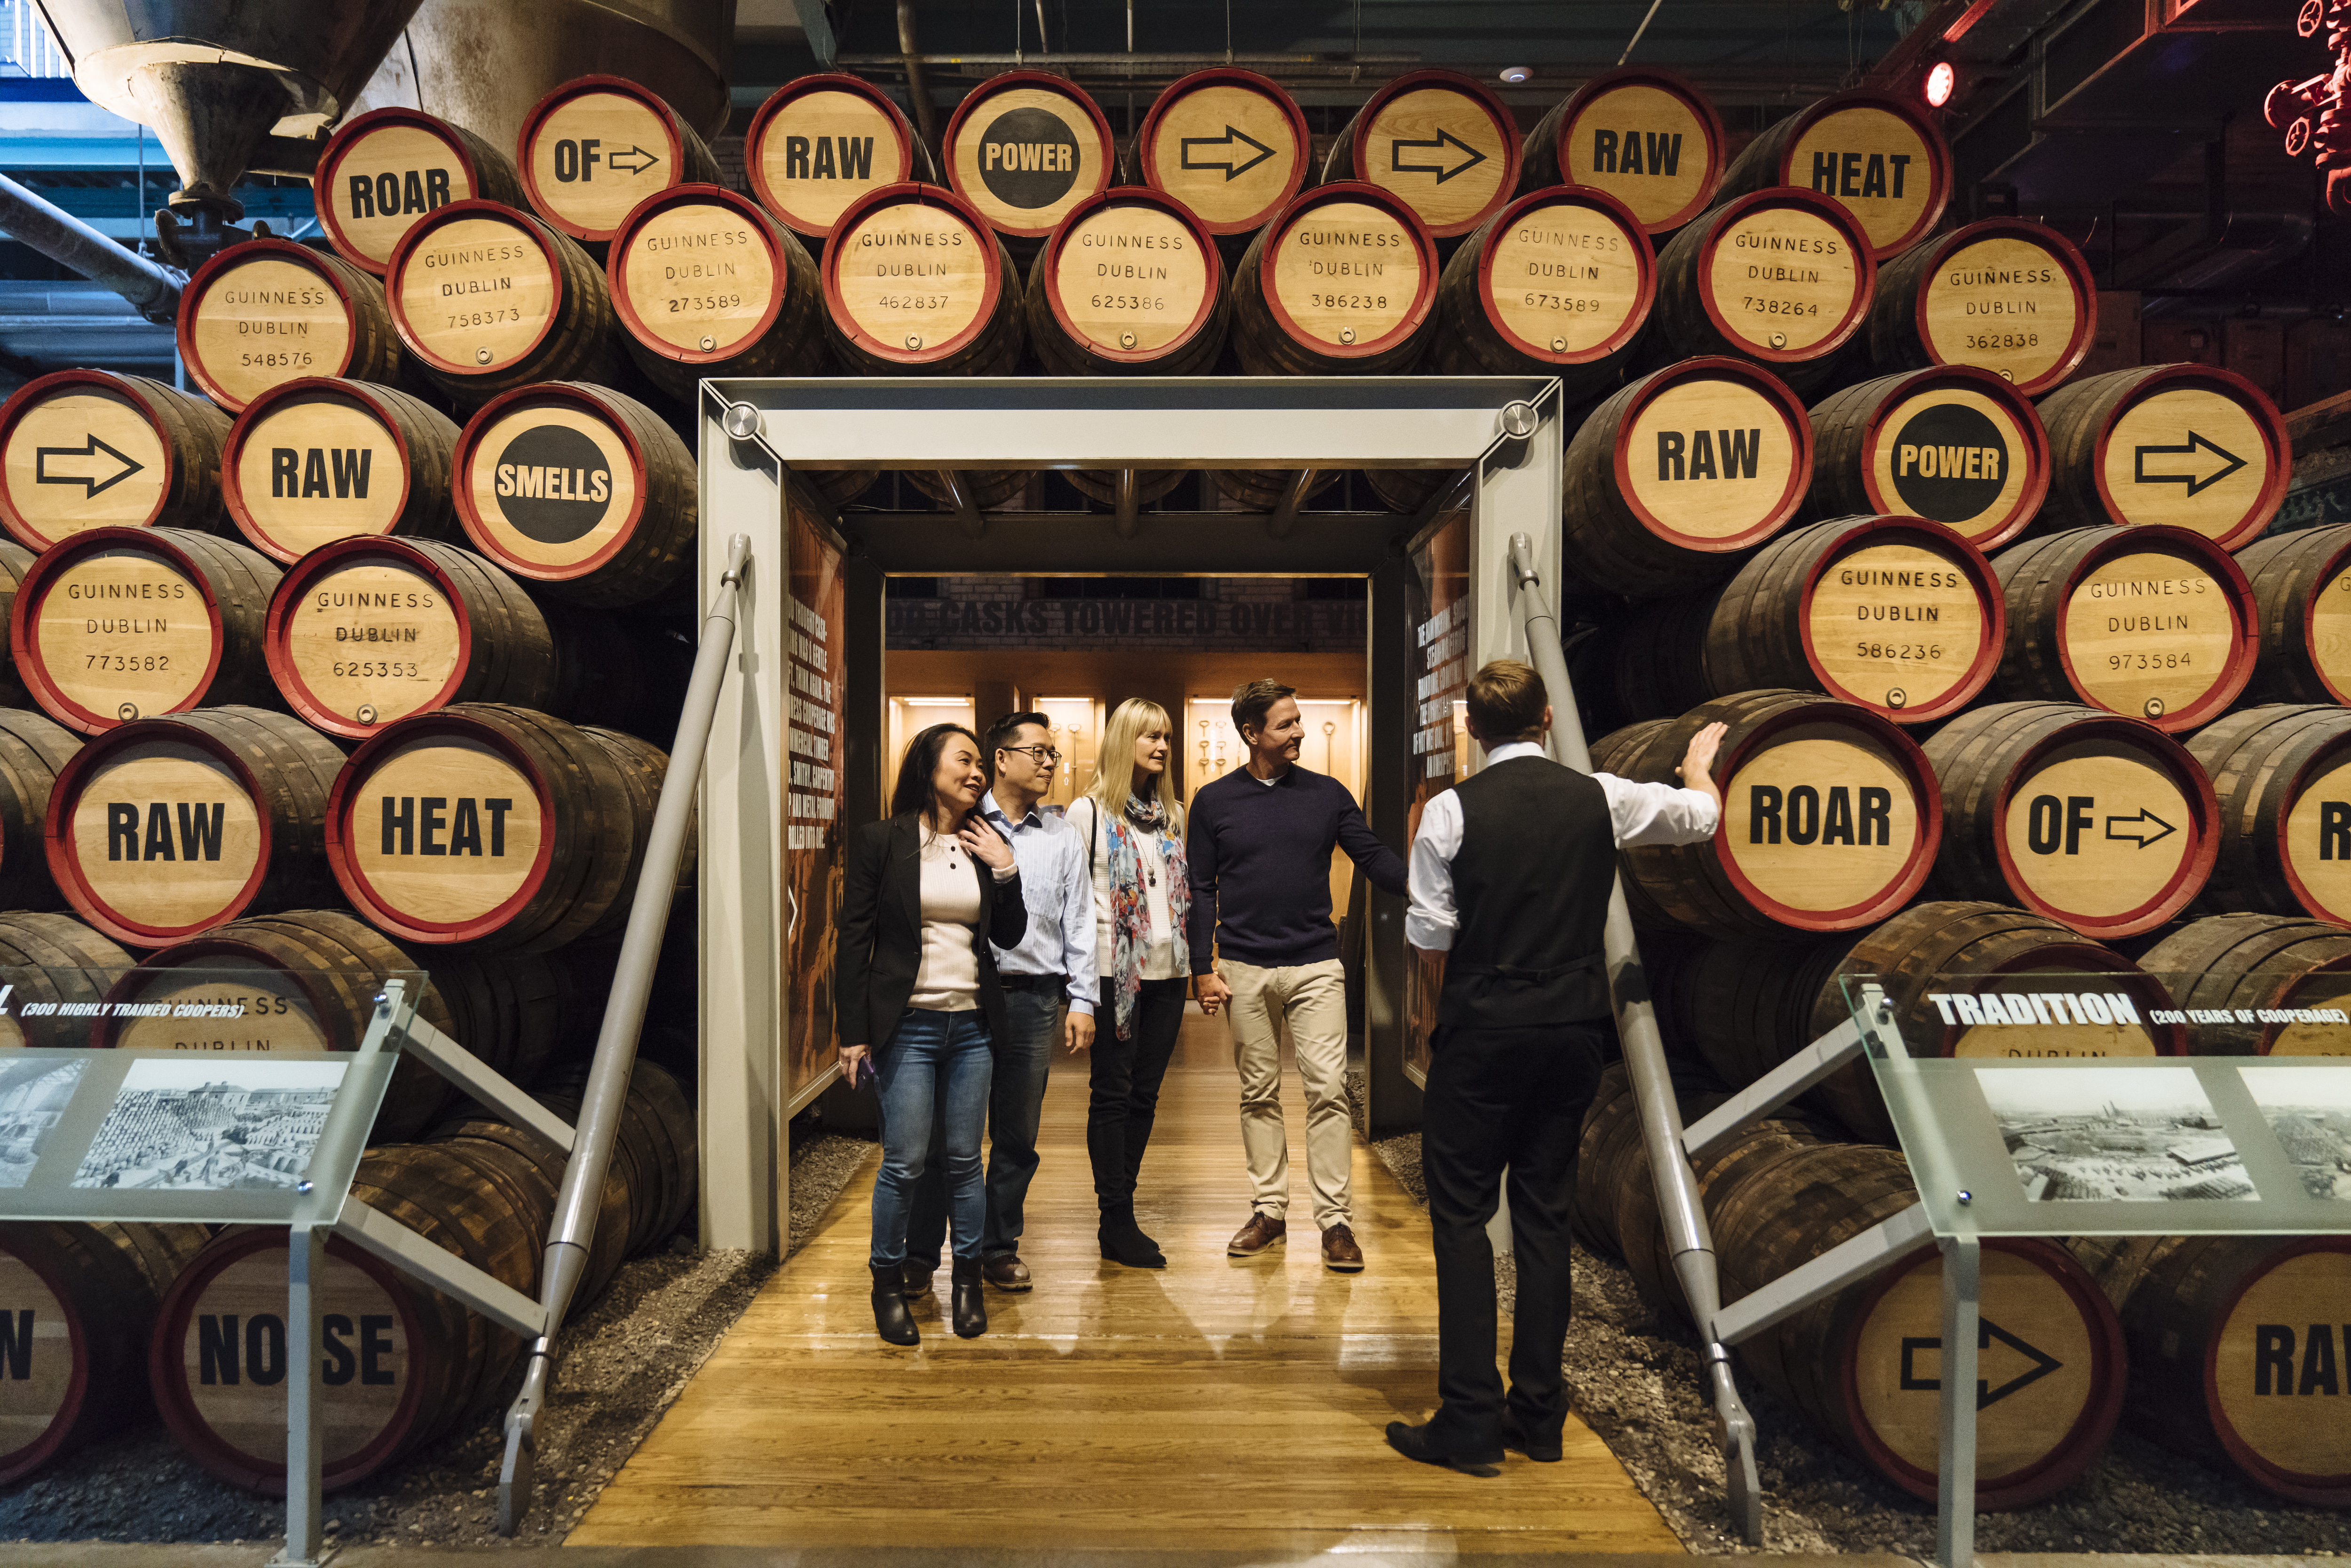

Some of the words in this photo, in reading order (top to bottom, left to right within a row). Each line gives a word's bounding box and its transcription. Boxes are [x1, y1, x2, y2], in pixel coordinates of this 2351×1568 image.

[554, 139, 600, 182] OF
[786, 136, 874, 180] RAW
[986, 143, 1072, 171] POWER
[1594, 129, 1682, 176] RAW
[1812, 152, 1910, 198] HEAT
[349, 168, 450, 219] ROAR
[647, 231, 747, 251] GUINNESS
[862, 233, 962, 246] GUINNESS
[1083, 234, 1183, 250] GUINNESS
[1300, 233, 1400, 247] GUINNESS
[1519, 230, 1618, 251] GUINNESS
[1736, 235, 1837, 254] GUINNESS
[426, 245, 523, 268] GUINNESS
[666, 262, 735, 279] DUBLIN
[877, 264, 946, 276] DUBLIN
[1097, 263, 1167, 279] DUBLIN
[1313, 262, 1383, 276] DUBLIN
[1530, 262, 1599, 279] DUBLIN
[1748, 266, 1819, 283] DUBLIN
[1950, 270, 2051, 286] GUINNESS
[442, 277, 511, 296] DUBLIN
[226, 292, 324, 304] GUINNESS
[669, 294, 740, 312] 273589
[879, 296, 948, 308] 462837
[1092, 295, 1164, 310] 625386
[1312, 294, 1387, 308] 386238
[1525, 293, 1599, 312] 673589
[1744, 297, 1818, 316] 738264
[1966, 300, 2036, 315] DUBLIN
[448, 308, 520, 328] 758373
[239, 322, 308, 334] DUBLIN
[1966, 334, 2038, 349] 362838
[242, 353, 312, 366] 548576
[1657, 429, 1760, 481] RAW
[1900, 445, 2000, 480] POWER
[272, 448, 371, 498] RAW
[497, 464, 608, 502] SMELLS
[1841, 571, 1957, 588] GUINNESS
[2091, 579, 2205, 598] GUINNESS
[69, 584, 184, 599] GUINNESS
[318, 593, 433, 607] GUINNESS
[795, 599, 815, 635] THOUGHT
[815, 614, 827, 642] CASK-
[940, 600, 1048, 634] CASKS
[1061, 602, 1217, 634] TOWERED
[1231, 602, 1313, 635] OVER
[1858, 606, 1939, 622] DUBLIN
[2109, 615, 2188, 632] DUBLIN
[87, 619, 167, 633] DUBLIN
[336, 627, 417, 642] DUBLIN
[789, 628, 797, 656] ING
[799, 634, 808, 662] WAS
[809, 641, 812, 664] A
[813, 643, 827, 673] GENTLE
[1857, 643, 1941, 659] 586236
[86, 655, 169, 671] 773582
[333, 662, 418, 677] 625353
[2109, 653, 2191, 670] 973584
[796, 664, 809, 694] THINK
[810, 672, 823, 701] AGAIN.
[803, 700, 826, 731] COOPERAGE
[827, 710, 835, 734] WAS
[789, 726, 813, 757] MMERCIAL
[813, 735, 828, 761] TIMBER
[1413, 733, 1418, 755] OF
[794, 760, 812, 789] SMITHY,
[813, 765, 835, 791] CARPENTRY
[792, 793, 802, 818] AND
[803, 795, 816, 819] METAL
[817, 796, 835, 820] FOUNDRY
[1750, 785, 1891, 845] ROAR
[108, 803, 225, 861] RAW
[381, 796, 512, 857] HEAT
[2028, 795, 2094, 855] OF
[788, 825, 805, 850] ROLLED
[806, 826, 815, 849] INTO
[816, 826, 825, 849] ONE.
[21, 1003, 57, 1017] (300
[57, 1003, 112, 1016] HIGHLY
[113, 1003, 169, 1017] TRAINED
[173, 1004, 245, 1018] COOPERS)
[1928, 993, 2141, 1025] TRADITION
[2150, 1010, 2186, 1025] (200
[2185, 1009, 2235, 1024] YEARS
[2234, 1009, 2255, 1023] OF
[2256, 1009, 2349, 1024] COOPERAGE)
[199, 1314, 395, 1385] NOSE
[2254, 1324, 2351, 1395] RA
